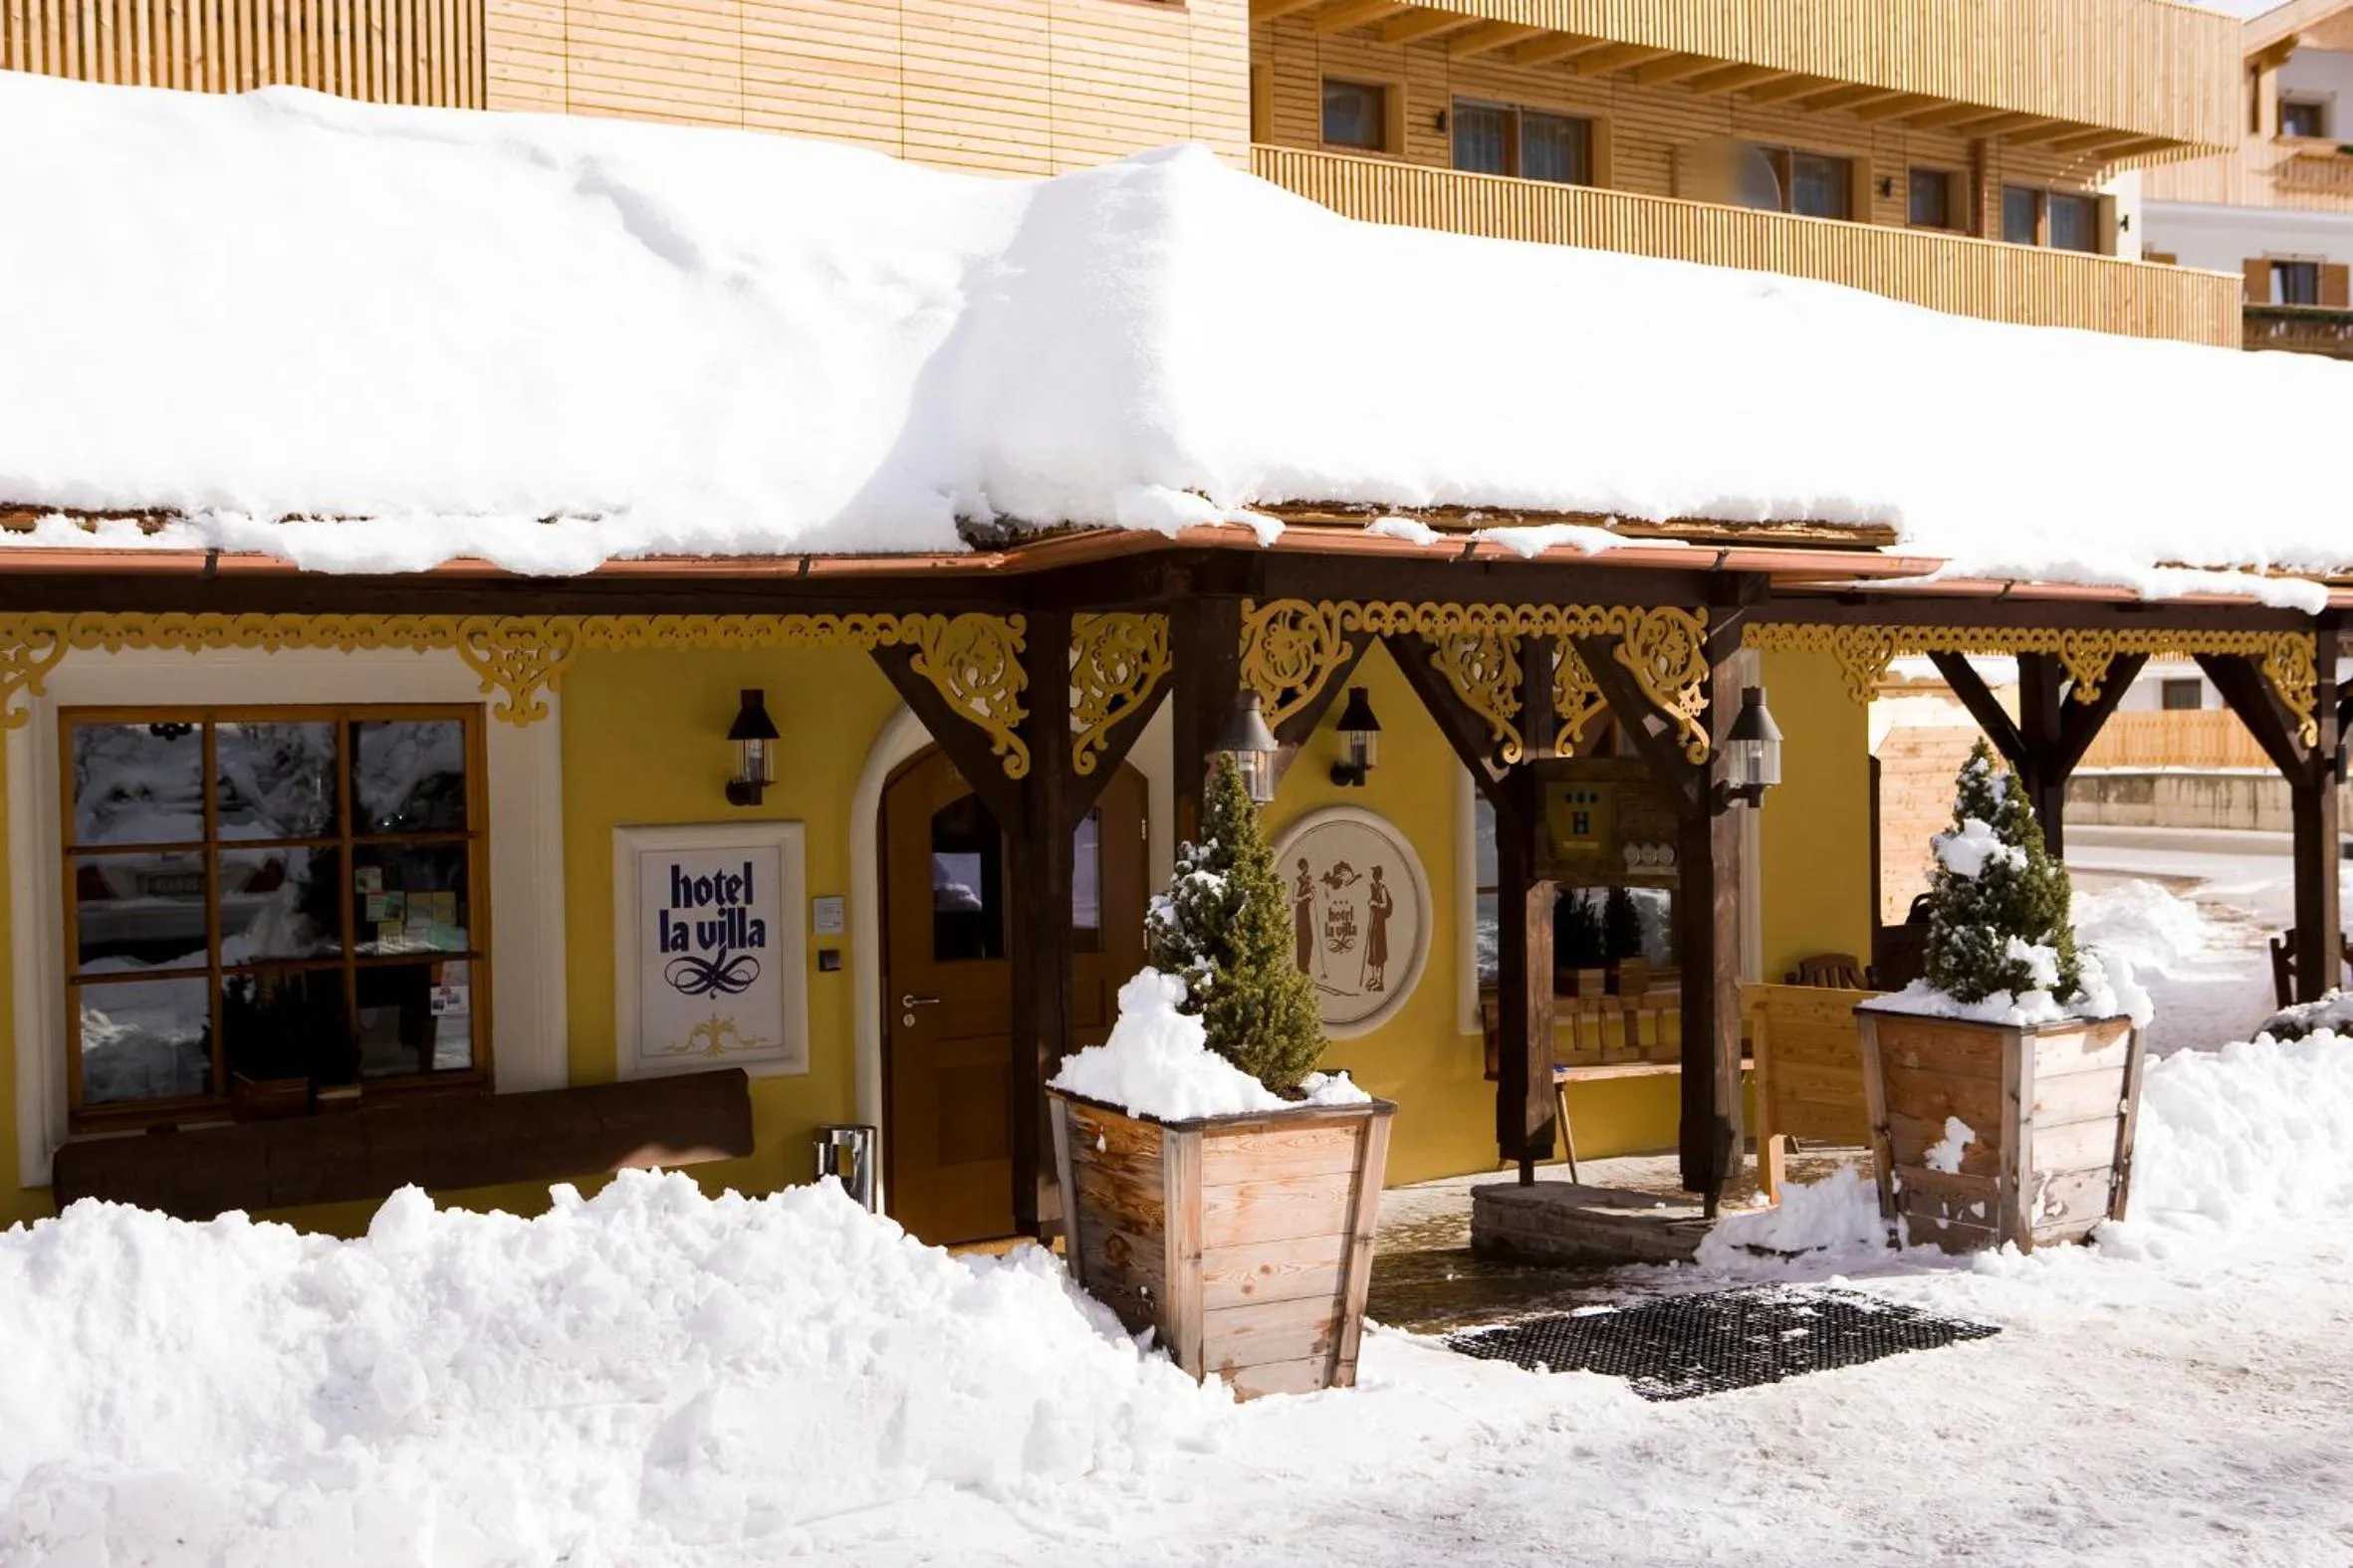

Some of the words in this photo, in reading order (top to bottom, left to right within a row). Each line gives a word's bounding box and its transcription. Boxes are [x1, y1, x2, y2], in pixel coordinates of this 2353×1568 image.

[1572, 810, 1589, 835] H
[671, 862, 754, 908] hotel
[659, 909, 689, 953] la
[696, 907, 766, 951] villa
[1325, 922, 1334, 938] la
[1336, 922, 1357, 938] villa
